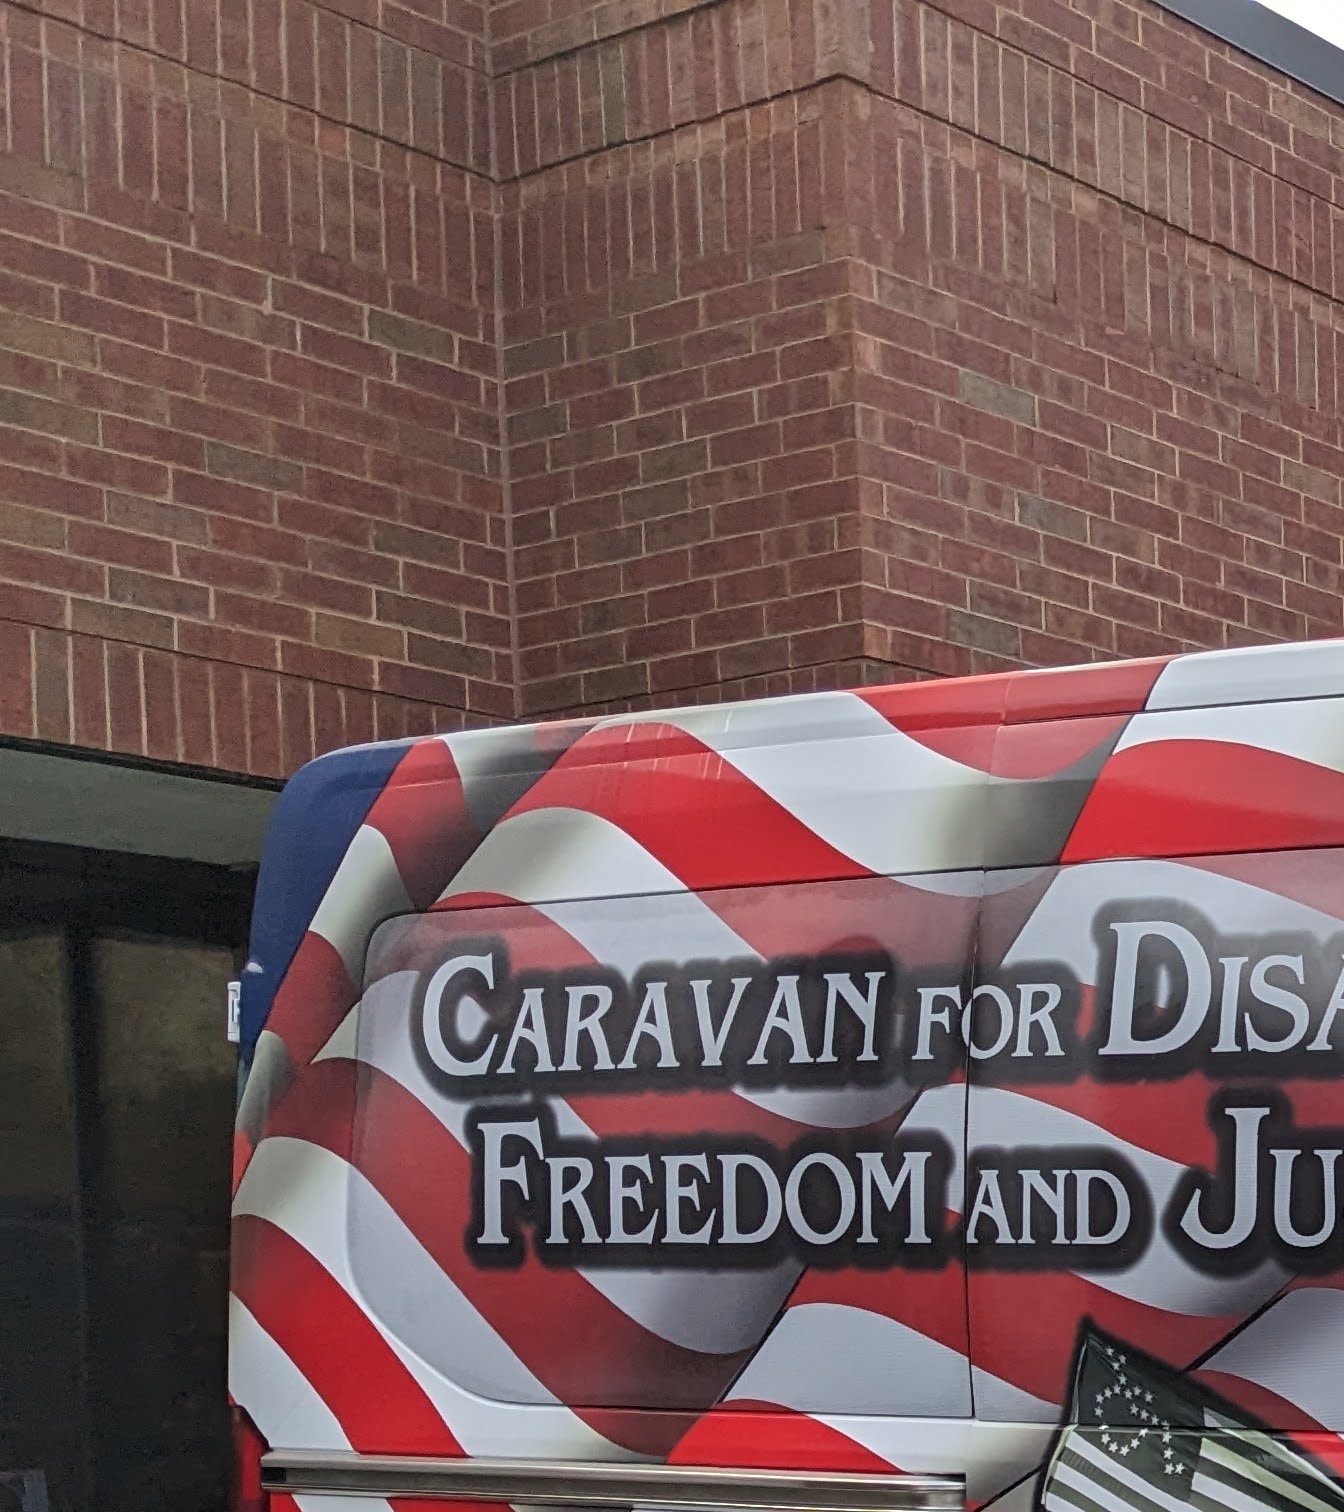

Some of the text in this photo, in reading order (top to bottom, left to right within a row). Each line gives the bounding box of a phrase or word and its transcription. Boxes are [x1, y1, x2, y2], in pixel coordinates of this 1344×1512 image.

[422, 954, 886, 1076] CARAVAN
[911, 983, 1064, 1059] FOR
[477, 1122, 931, 1245] FREEDOM
[966, 1170, 1131, 1245] AND
